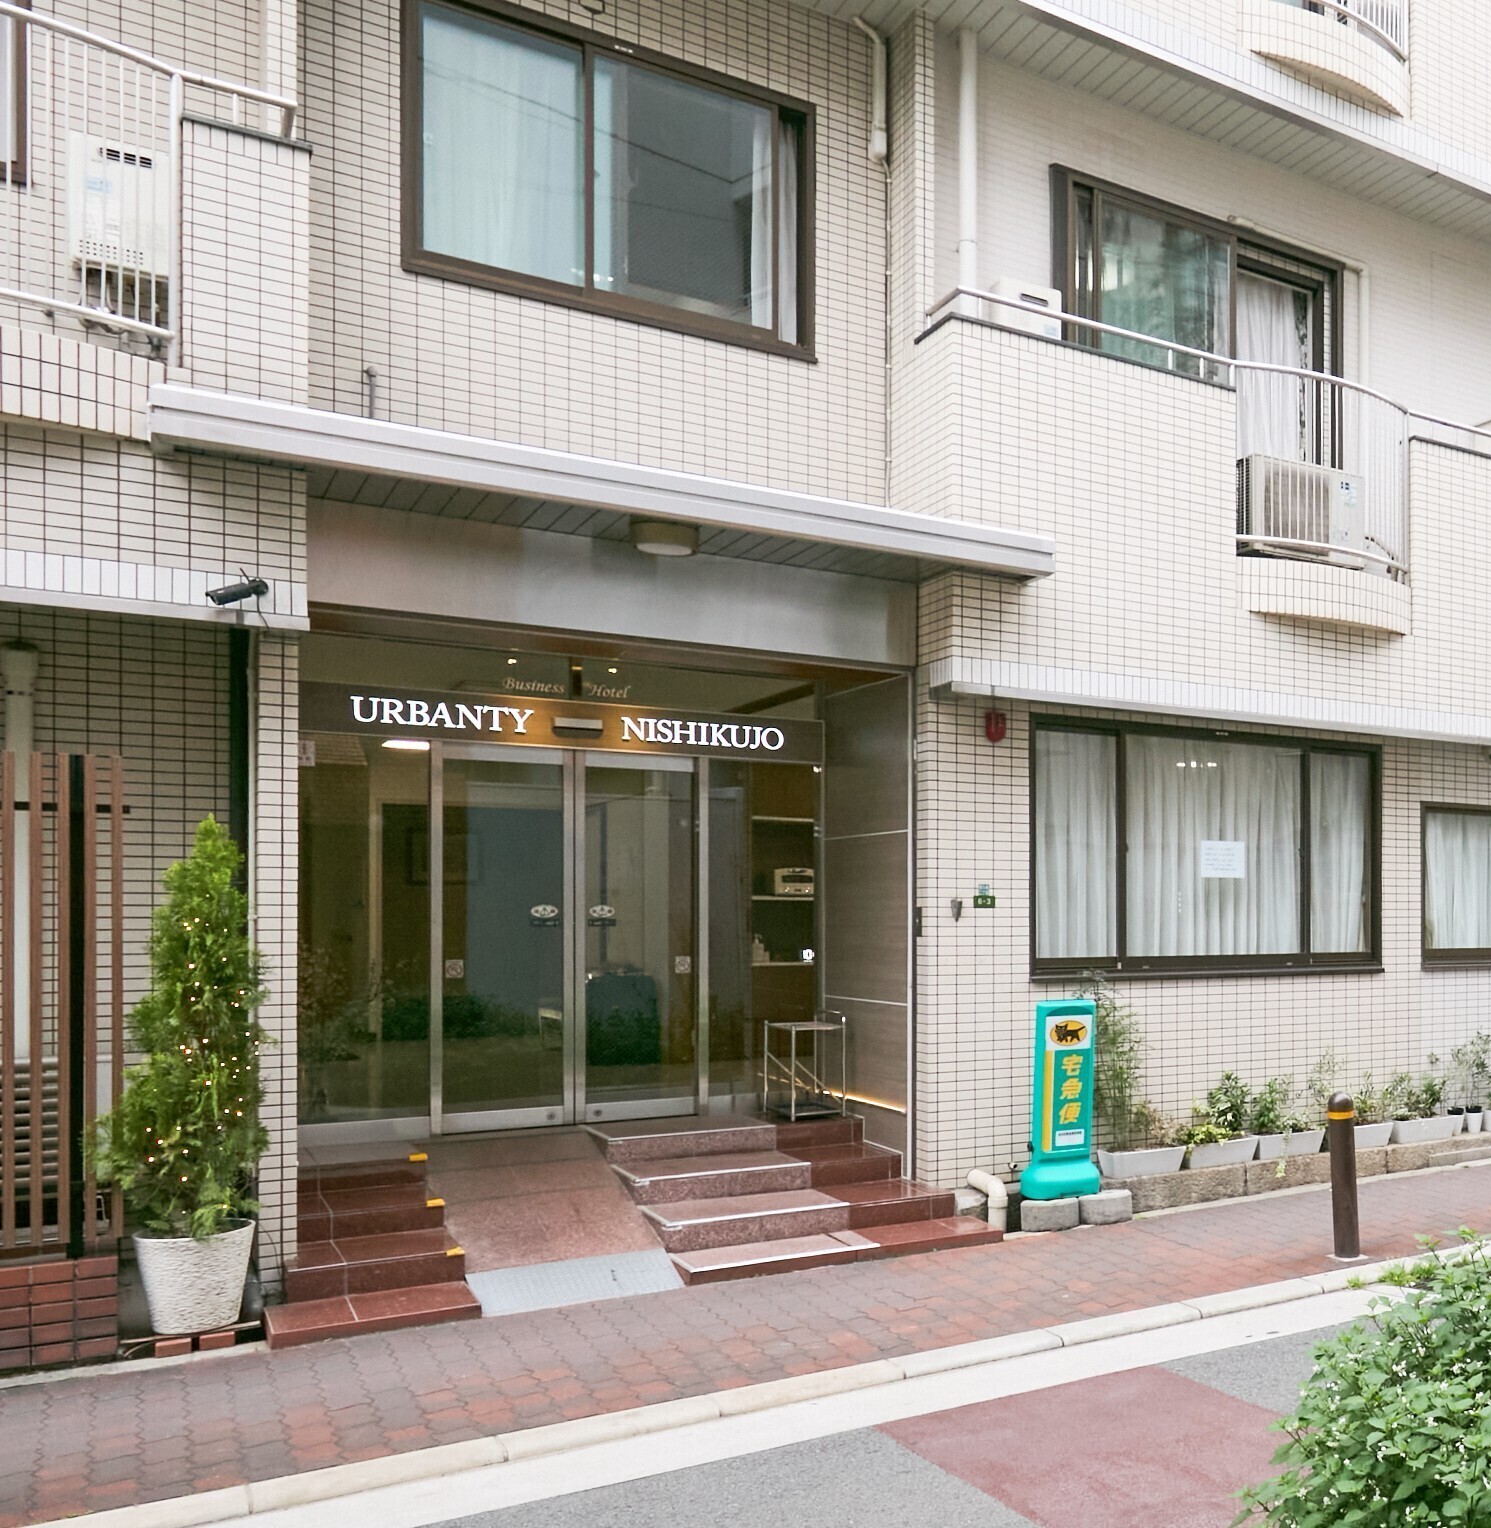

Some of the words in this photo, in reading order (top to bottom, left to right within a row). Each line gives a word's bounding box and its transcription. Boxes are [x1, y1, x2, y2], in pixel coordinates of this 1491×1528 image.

[502, 676, 565, 695] Business
[583, 681, 631, 699] Hotel
[350, 695, 534, 735] URBANTY
[621, 716, 785, 751] NISHIKUJO
[1059, 1053, 1084, 1125] 宅急便
